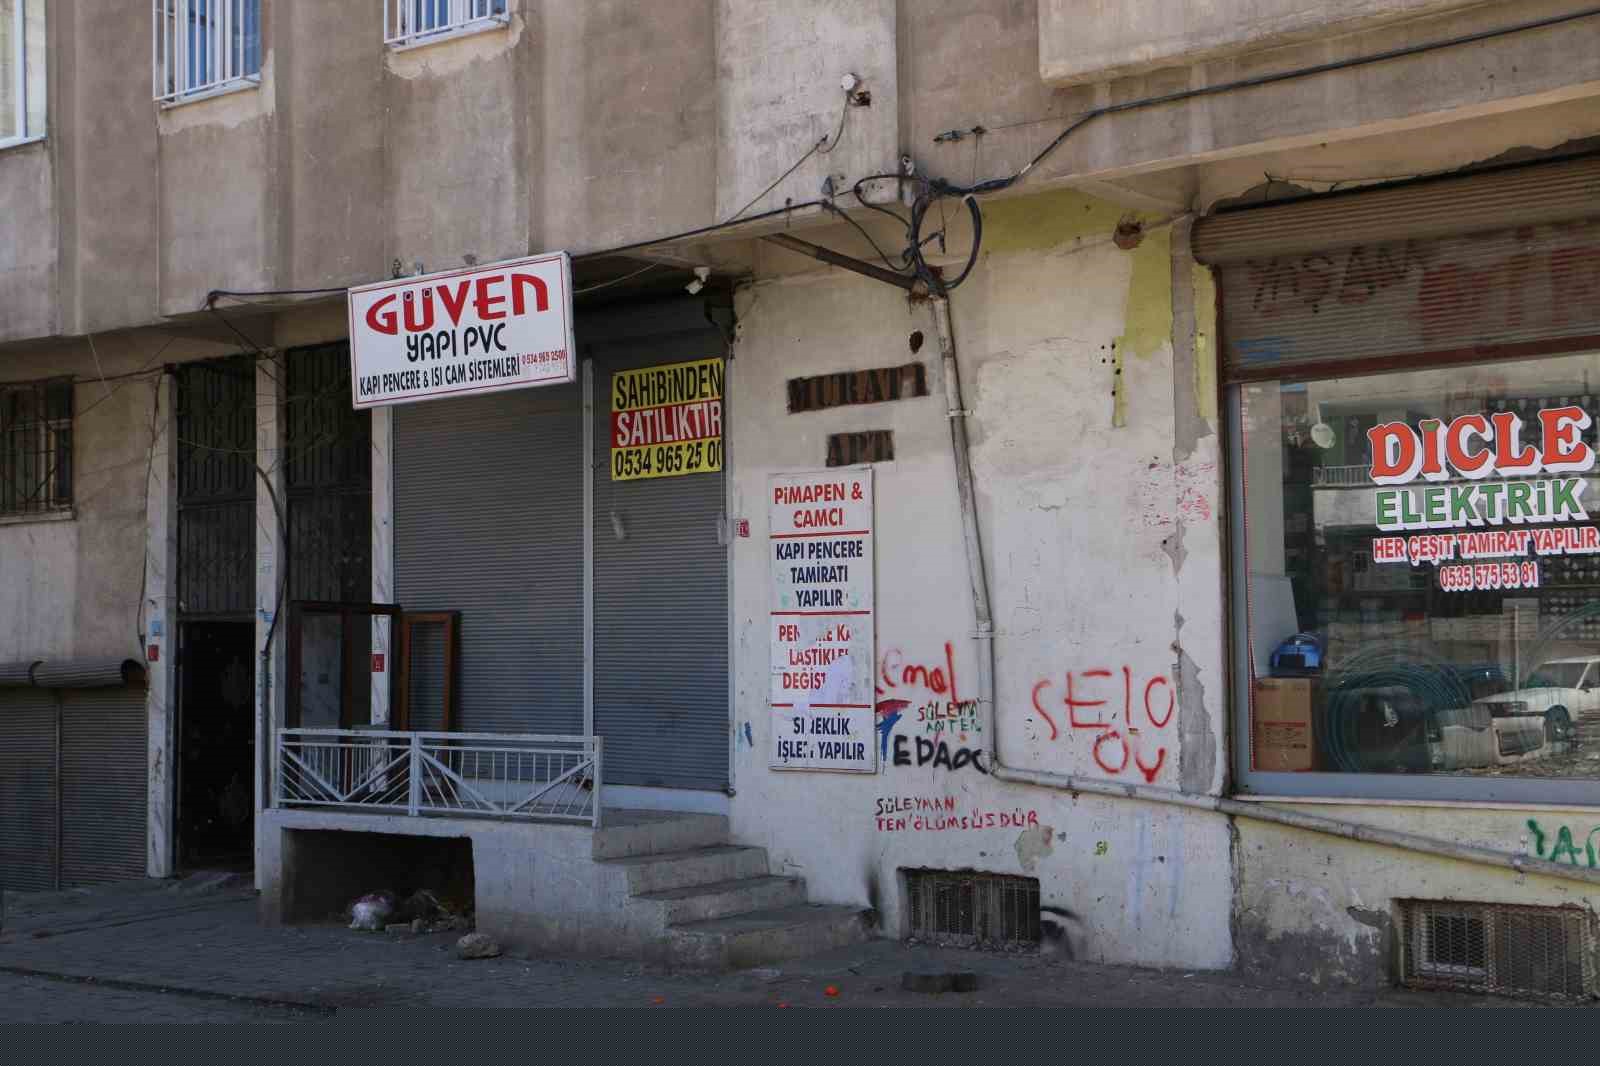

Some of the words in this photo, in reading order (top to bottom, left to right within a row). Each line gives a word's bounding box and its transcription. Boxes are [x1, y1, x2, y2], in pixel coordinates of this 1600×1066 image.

[365, 273, 549, 335] GÜVEN
[406, 329, 457, 362] YAPI
[463, 322, 507, 355] PVC
[359, 374, 381, 396] KAPI
[383, 369, 420, 392] PENCERE
[423, 373, 429, 388] &
[431, 368, 443, 386] ISI
[445, 364, 467, 384] CAM
[617, 401, 721, 447] SATILIKTIR
[615, 448, 652, 476] 0534
[656, 445, 683, 473] 965
[686, 442, 703, 469] 25
[851, 481, 863, 500] &
[793, 507, 843, 528] CAMCI
[776, 542, 804, 560] KAPI
[808, 540, 863, 559] PENCERE
[1373, 537, 1408, 563] HER
[1531, 526, 1600, 556] YAPILIR
[1440, 565, 1474, 592] 0535
[1474, 563, 1501, 590] 575
[1501, 562, 1520, 589] 53
[1520, 560, 1538, 588] 81
[796, 589, 843, 607] YAPILIR
[818, 741, 865, 761] YAPILIR
